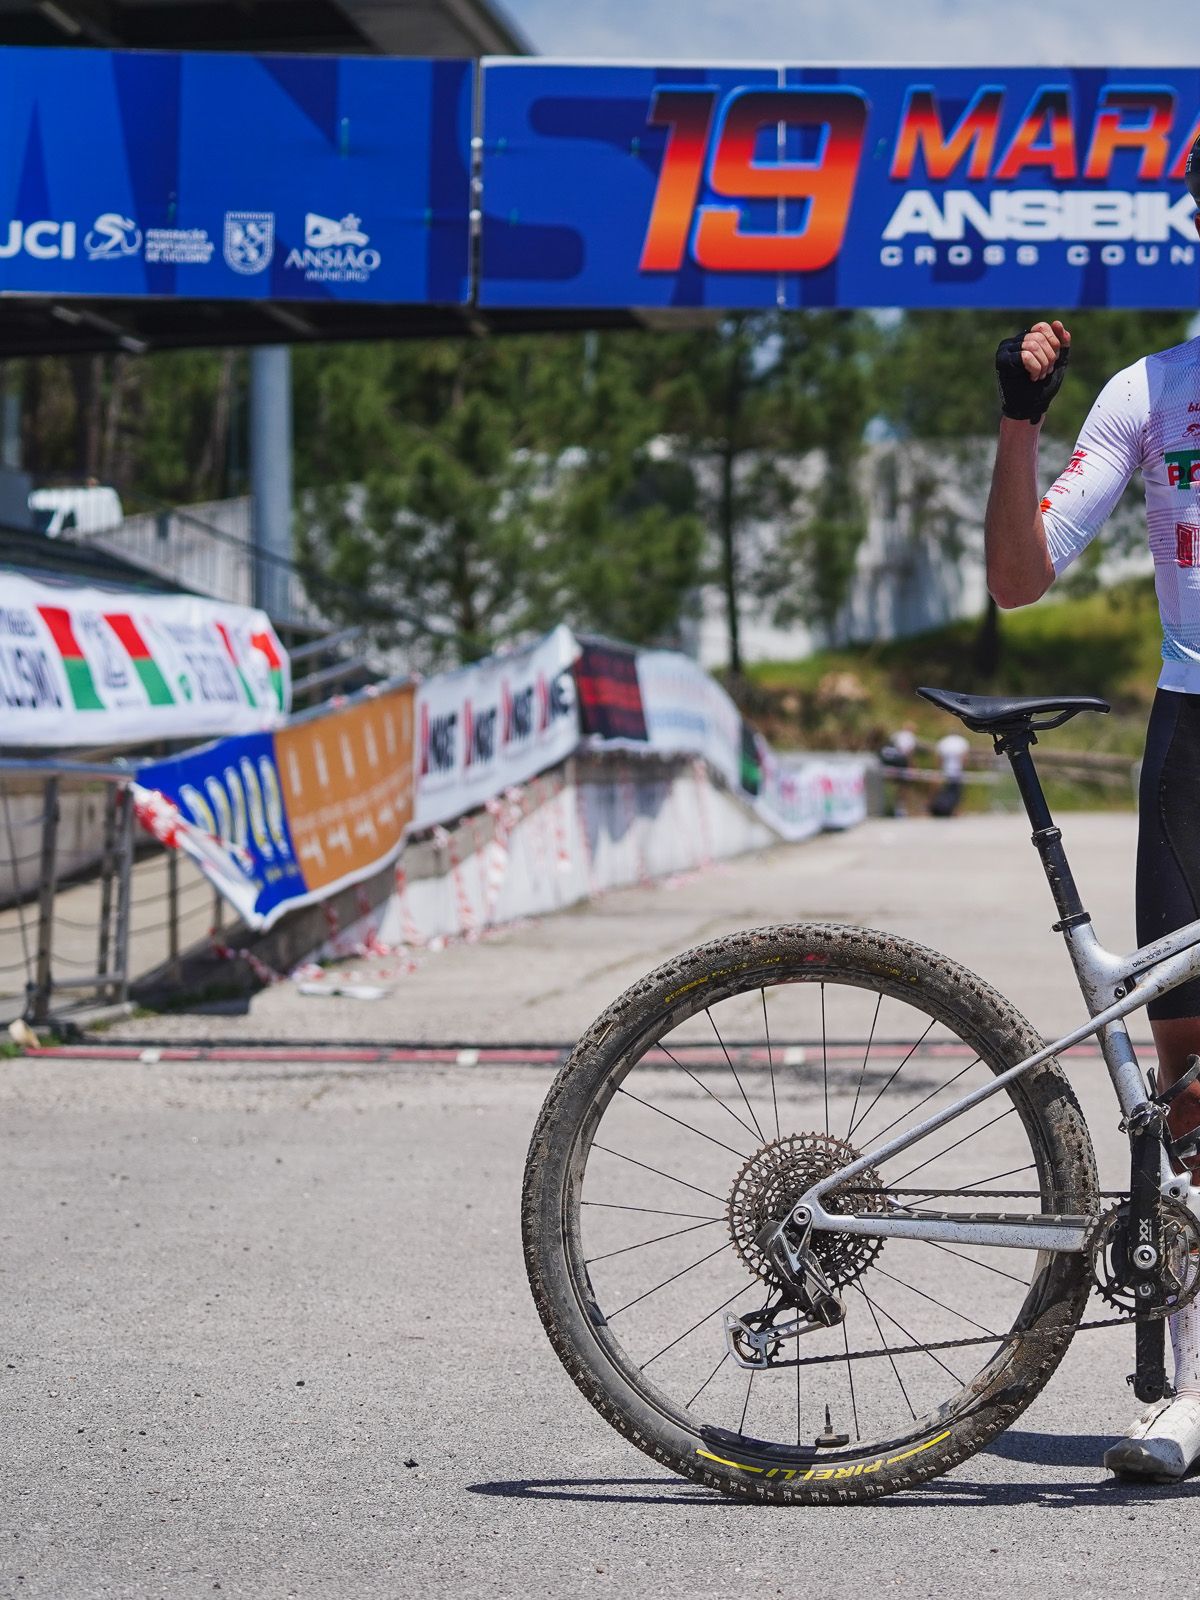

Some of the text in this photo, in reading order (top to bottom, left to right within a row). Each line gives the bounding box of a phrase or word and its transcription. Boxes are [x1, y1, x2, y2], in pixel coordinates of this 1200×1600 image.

[640, 85, 870, 272] 19
[284, 248, 381, 271] ANSIÃO
[880, 245, 1039, 267] CROSS
[1067, 246, 1194, 266] COUN
[766, 1459, 883, 1481] PIRELLI
